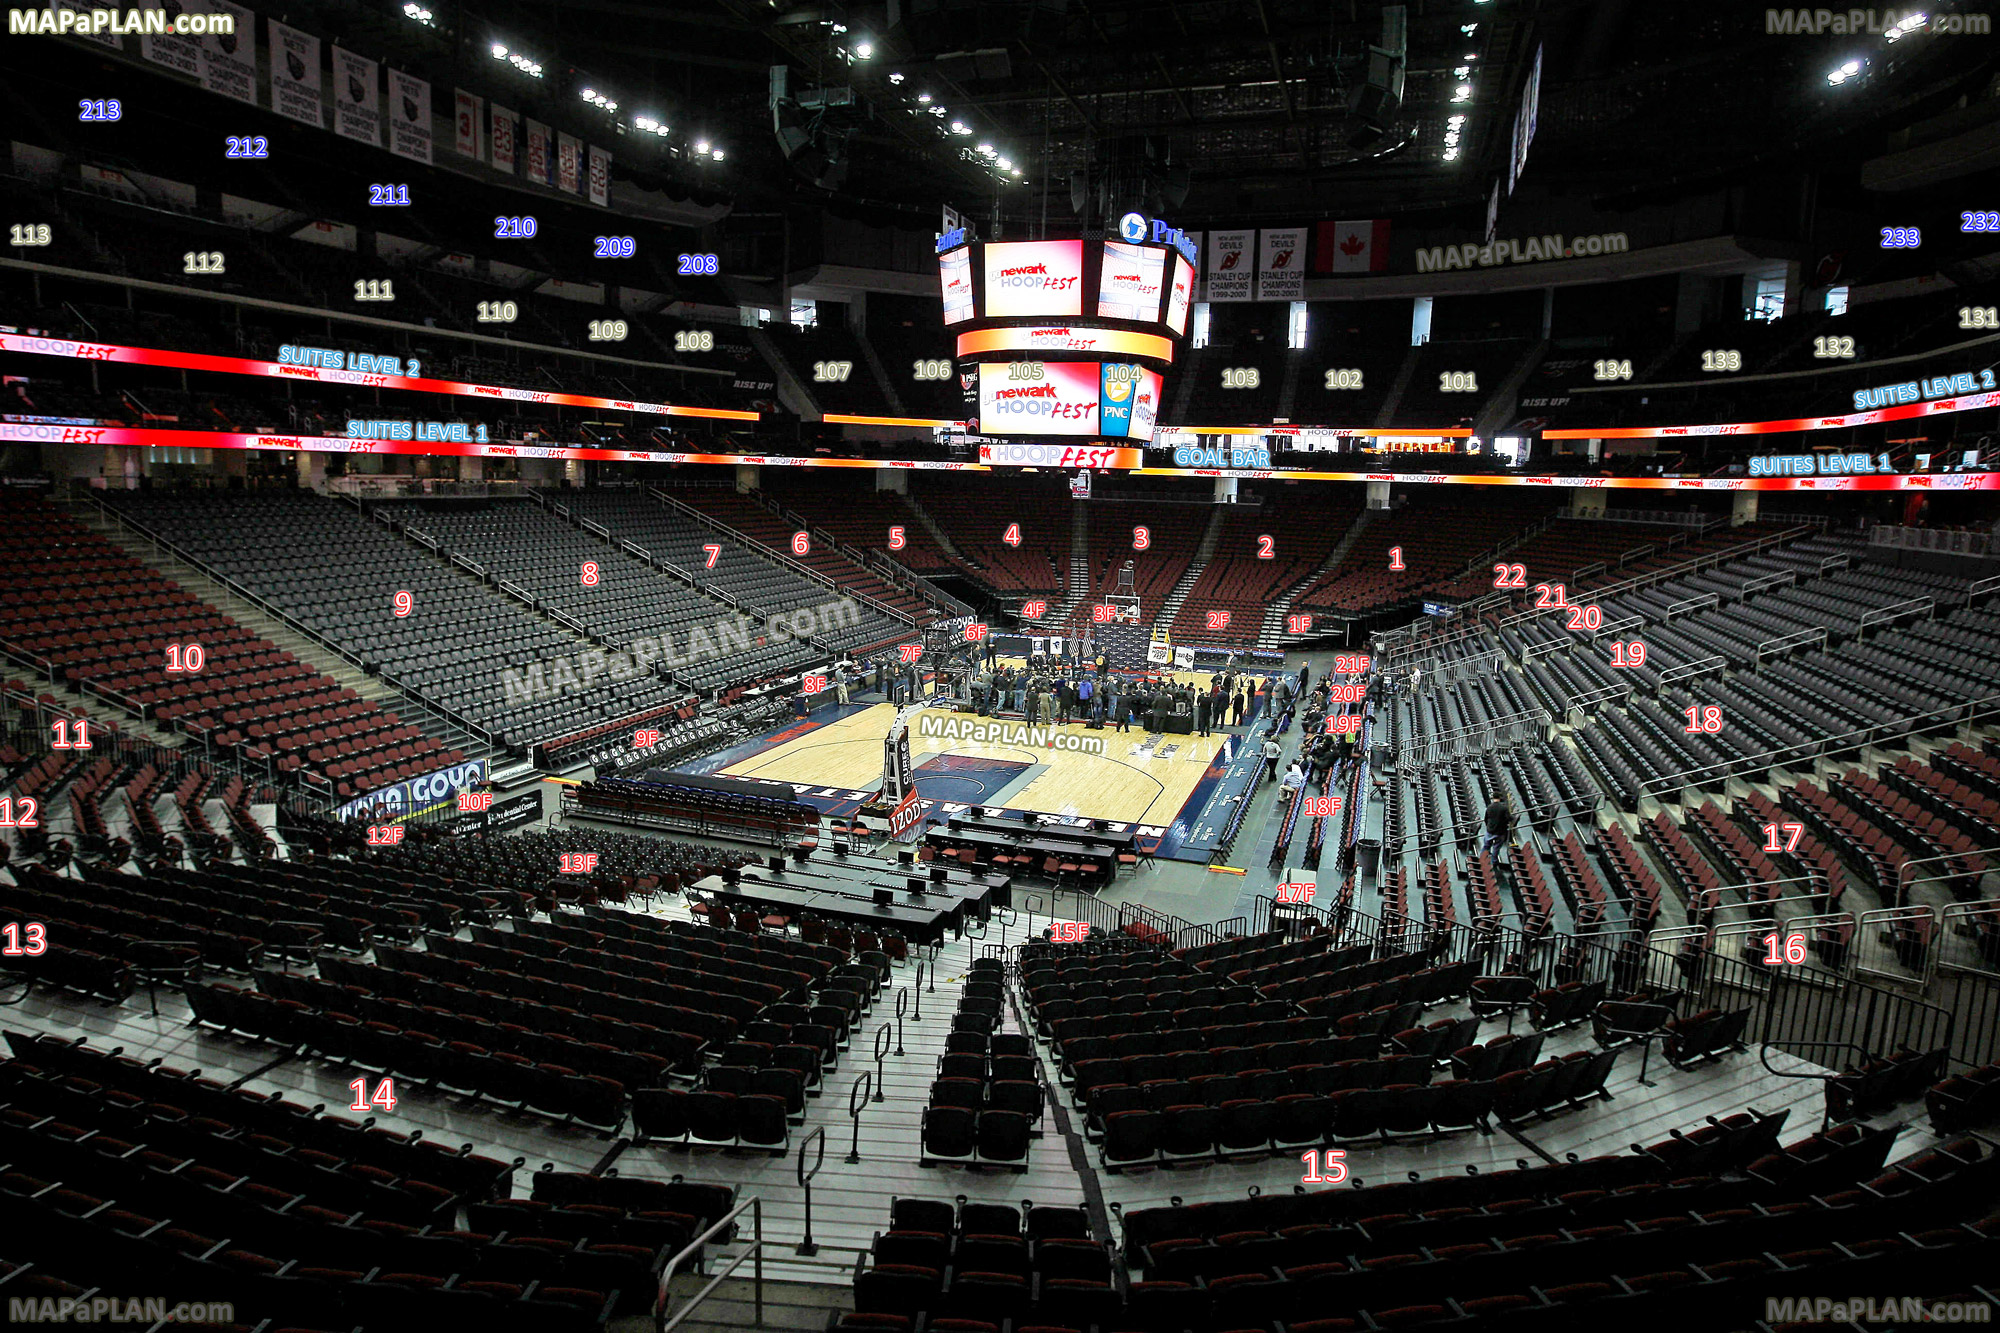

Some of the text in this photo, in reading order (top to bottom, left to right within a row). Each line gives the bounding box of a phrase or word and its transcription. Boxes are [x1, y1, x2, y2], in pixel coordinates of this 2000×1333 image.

[1220, 242, 1243, 250] DEVILS
[1271, 240, 1295, 248] DEVILS
[1209, 272, 1251, 281] STANLEY CUP
[1260, 271, 1303, 280] STANLEY CUP
[1001, 276, 1077, 290] HOOPFEST
[1113, 281, 1158, 294] HOOPFEST
[1210, 282, 1249, 290] CHAMPIONS
[1261, 280, 1300, 289] CHAMPIONS
[1031, 337, 1096, 349] HOOPFEST
[21, 339, 116, 360] HOOPFEST
[330, 372, 387, 387] HOOPFEST
[733, 380, 774, 390] RISE UP!
[509, 390, 550, 403] HOOPFEST
[1522, 398, 1570, 406] RISE UP!
[997, 401, 1097, 419] HOOPFEST
[1104, 406, 1128, 418] PNC
[2, 425, 105, 443] HOOPFEST
[1695, 426, 1740, 435] HOOPFEST
[313, 439, 376, 452] HOOPFEST
[524, 447, 566, 458] HOOPFEST
[654, 453, 686, 462] HOOPFEST
[997, 446, 1115, 468] HOOPFEST
[770, 458, 808, 467] HOOPFEST
[1402, 475, 1447, 483] HOOPFEST
[1560, 478, 1605, 487] HOOPFEST
[1708, 480, 1743, 490] HOOPFEST
[412, 763, 481, 803] GOYA
[891, 803, 921, 835] IZOD
